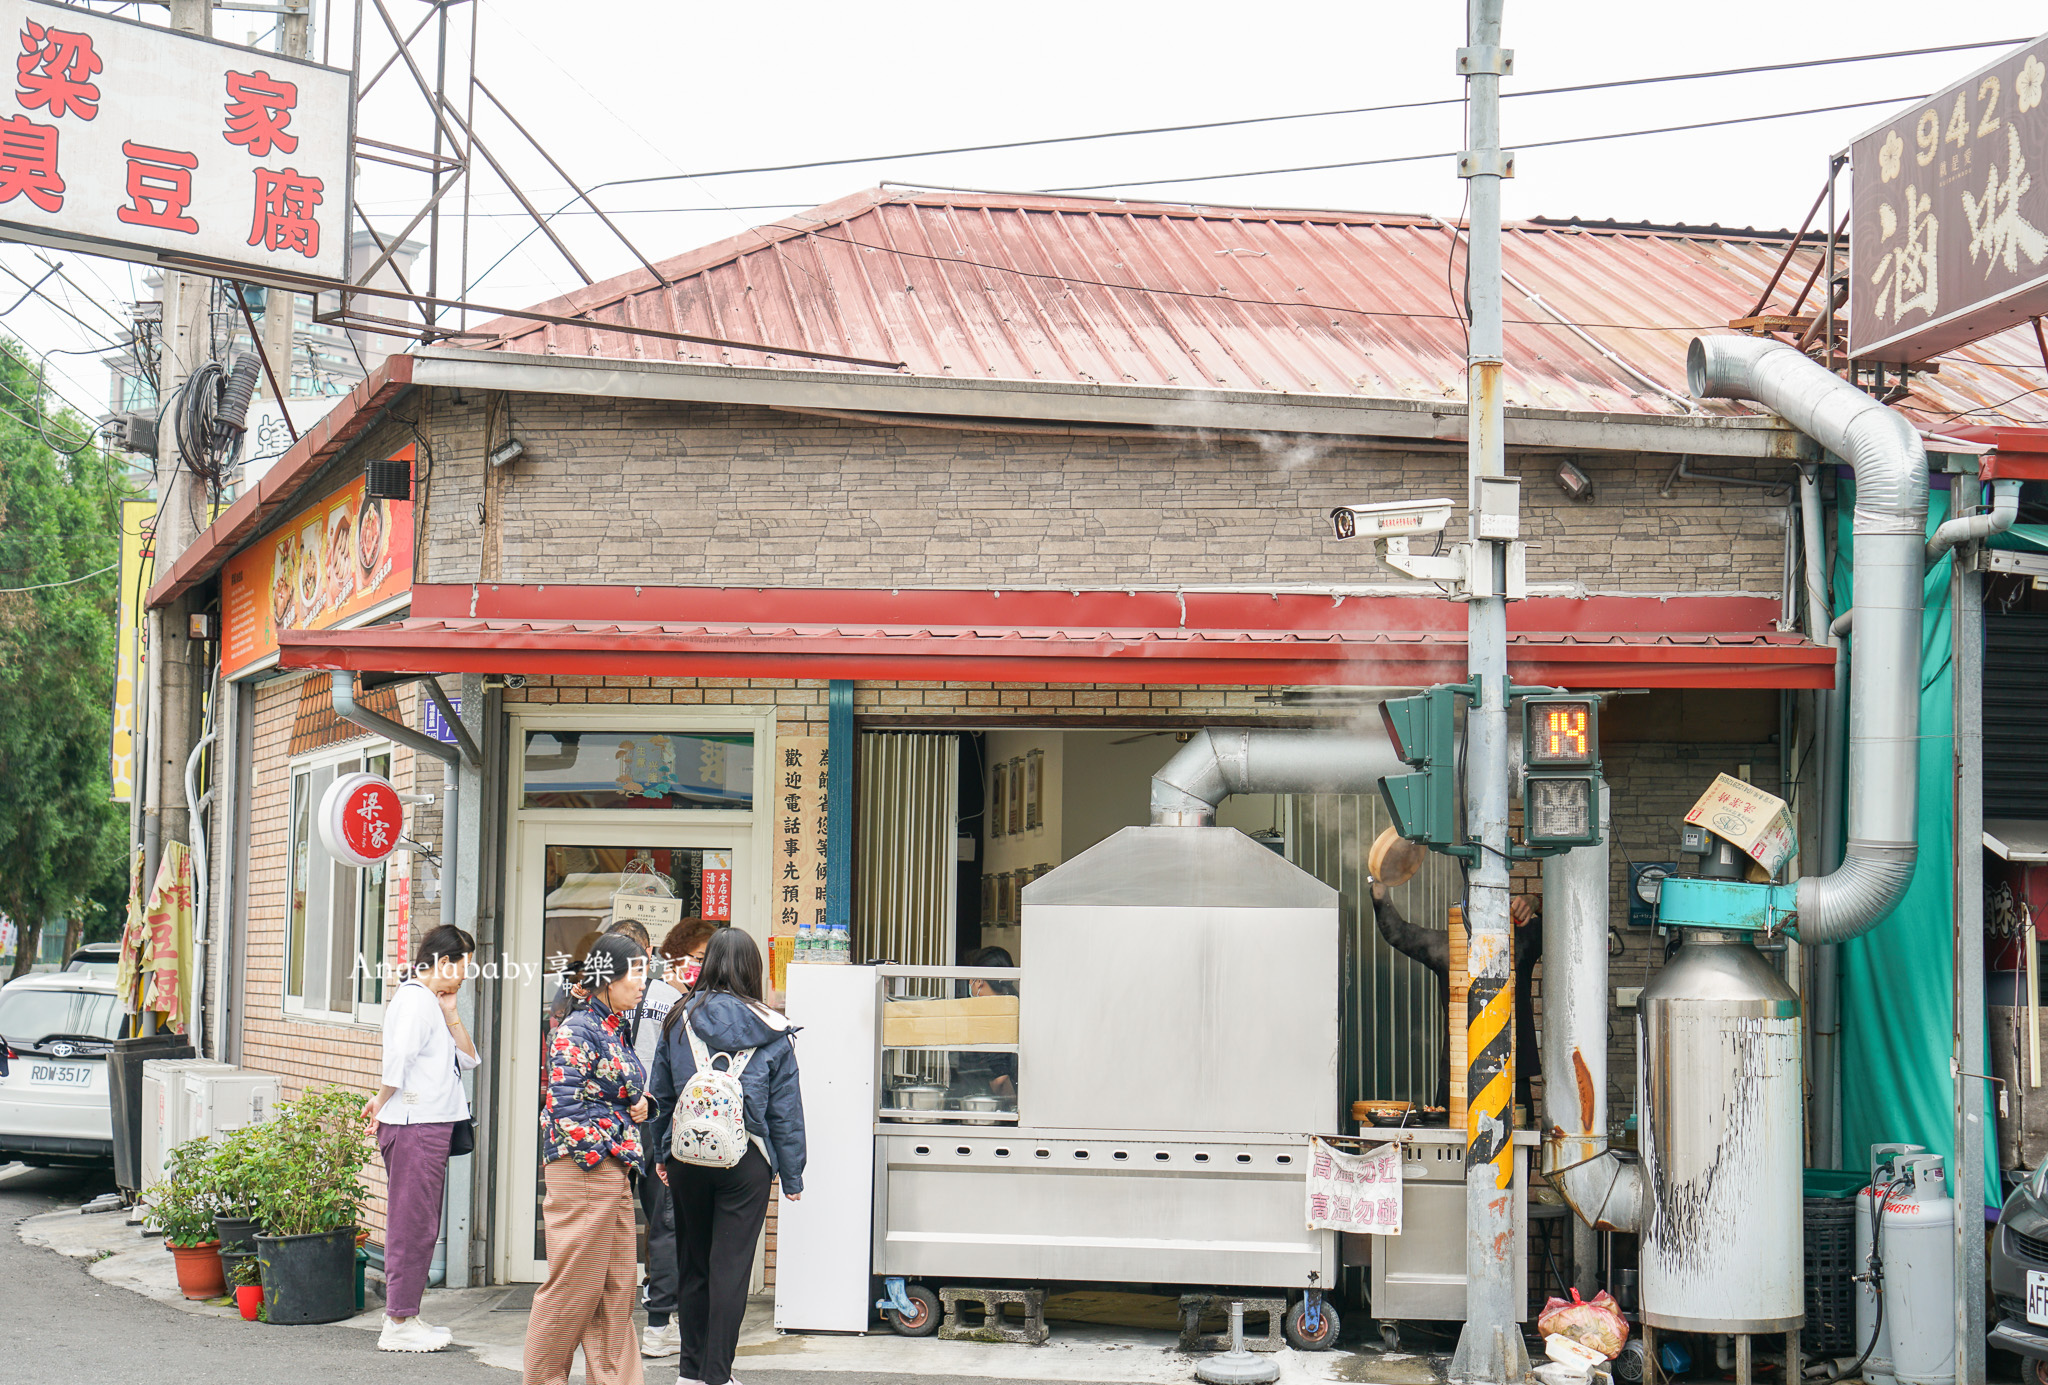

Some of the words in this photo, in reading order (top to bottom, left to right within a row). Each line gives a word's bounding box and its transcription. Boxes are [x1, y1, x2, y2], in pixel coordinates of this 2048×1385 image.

[15, 17, 299, 157] 梁家
[1916, 76, 2001, 167] 942
[0, 114, 324, 258] 臭豆腐
[1404, 560, 1411, 568] 4
[1550, 711, 1586, 755] 14
[356, 792, 390, 849] 梁家
[781, 748, 803, 926] 歡迎電話事先預約
[705, 872, 717, 917] 清潔消毒
[717, 872, 729, 917] 本店定時
[1310, 1193, 1398, 1225] 高溫勿碰
[1883, 1202, 1920, 1215] 4686
